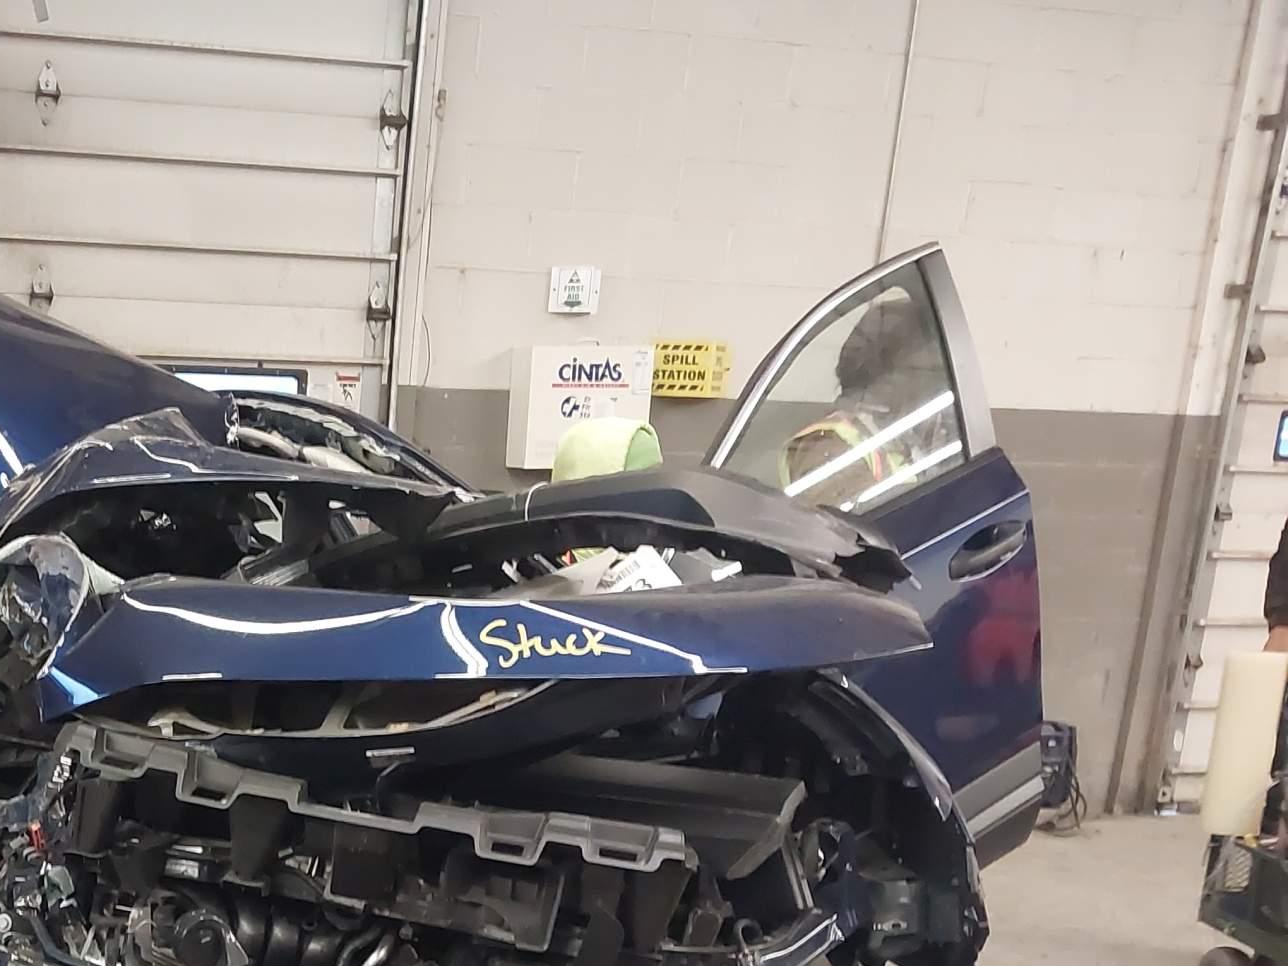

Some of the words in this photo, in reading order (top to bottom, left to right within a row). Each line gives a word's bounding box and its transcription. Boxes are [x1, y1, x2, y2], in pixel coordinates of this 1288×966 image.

[663, 354, 699, 366] SPILL
[653, 369, 706, 381] STATION
[479, 618, 632, 669] Stuck
